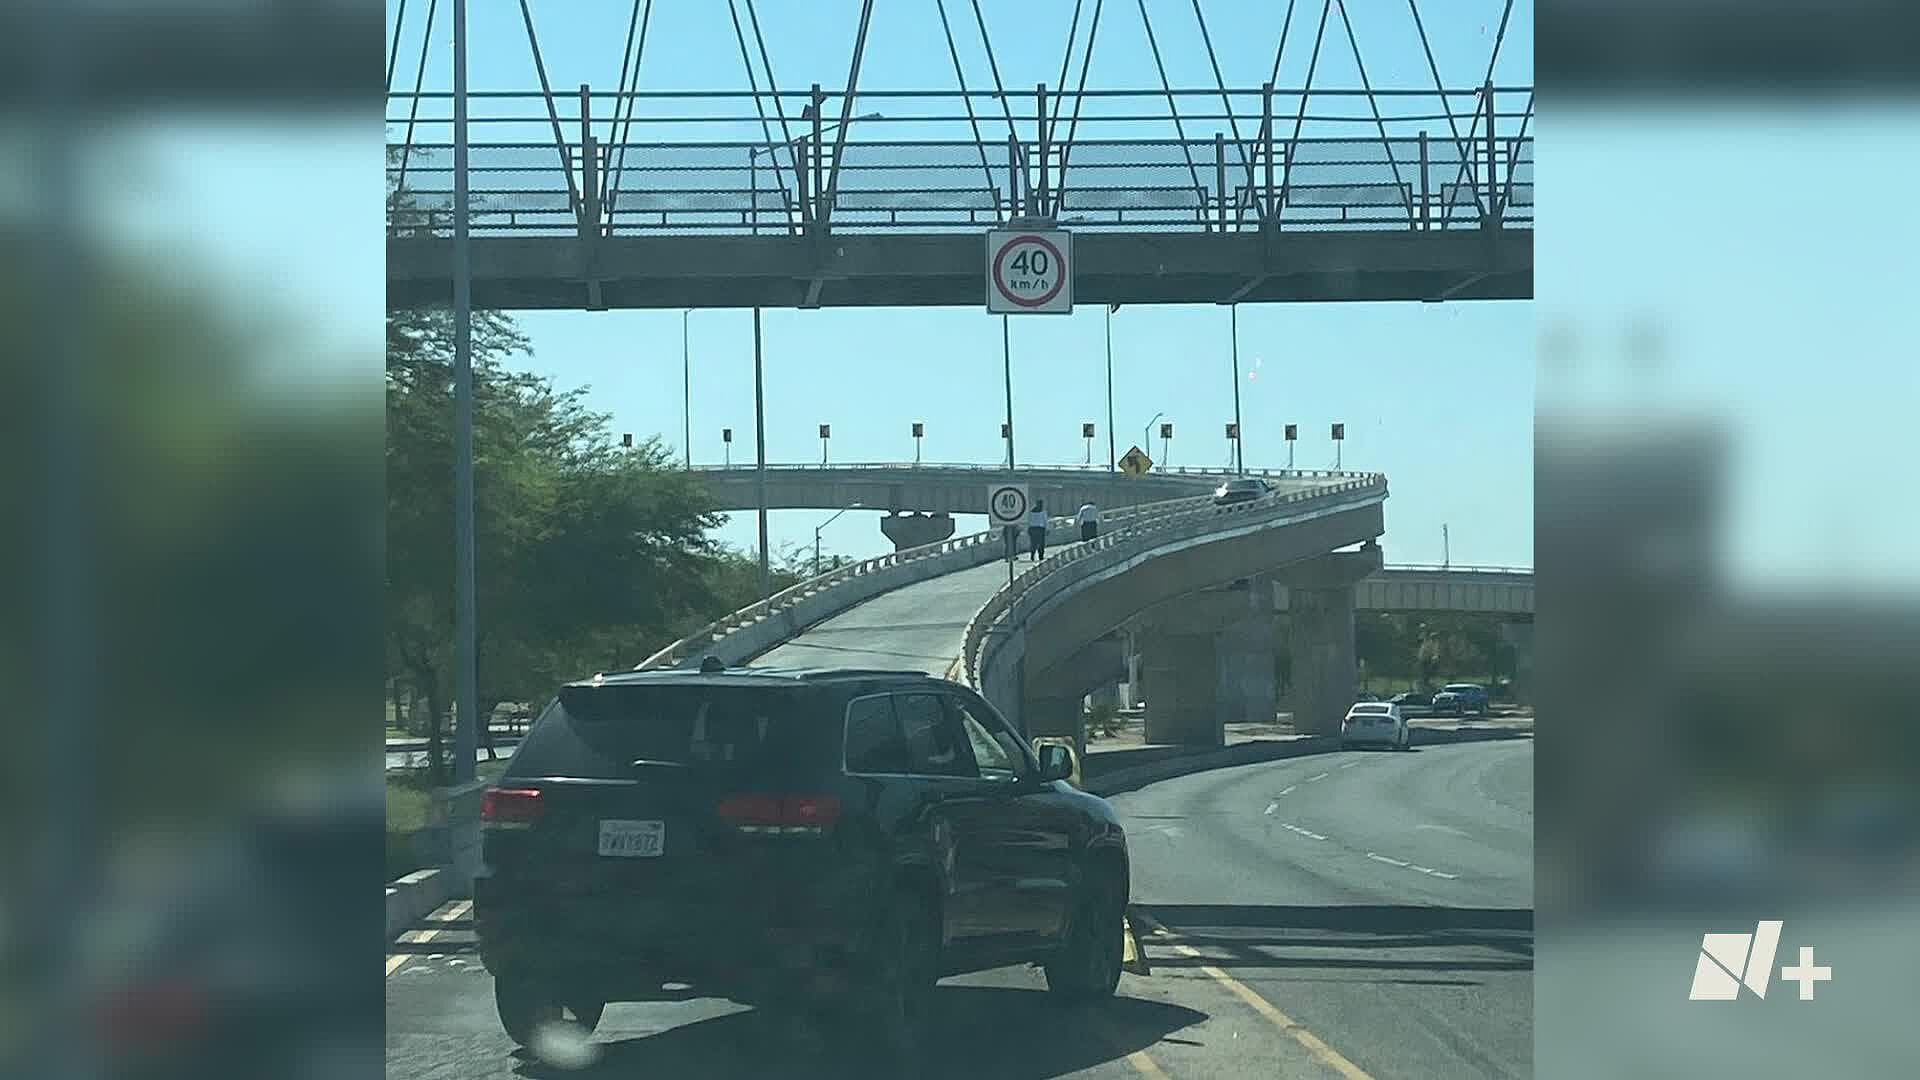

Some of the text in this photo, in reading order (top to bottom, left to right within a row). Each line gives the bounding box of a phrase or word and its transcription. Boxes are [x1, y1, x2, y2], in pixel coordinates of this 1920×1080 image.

[1011, 250, 1048, 275] 40
[1010, 279, 1049, 289] km/h
[1002, 494, 1016, 508] 40
